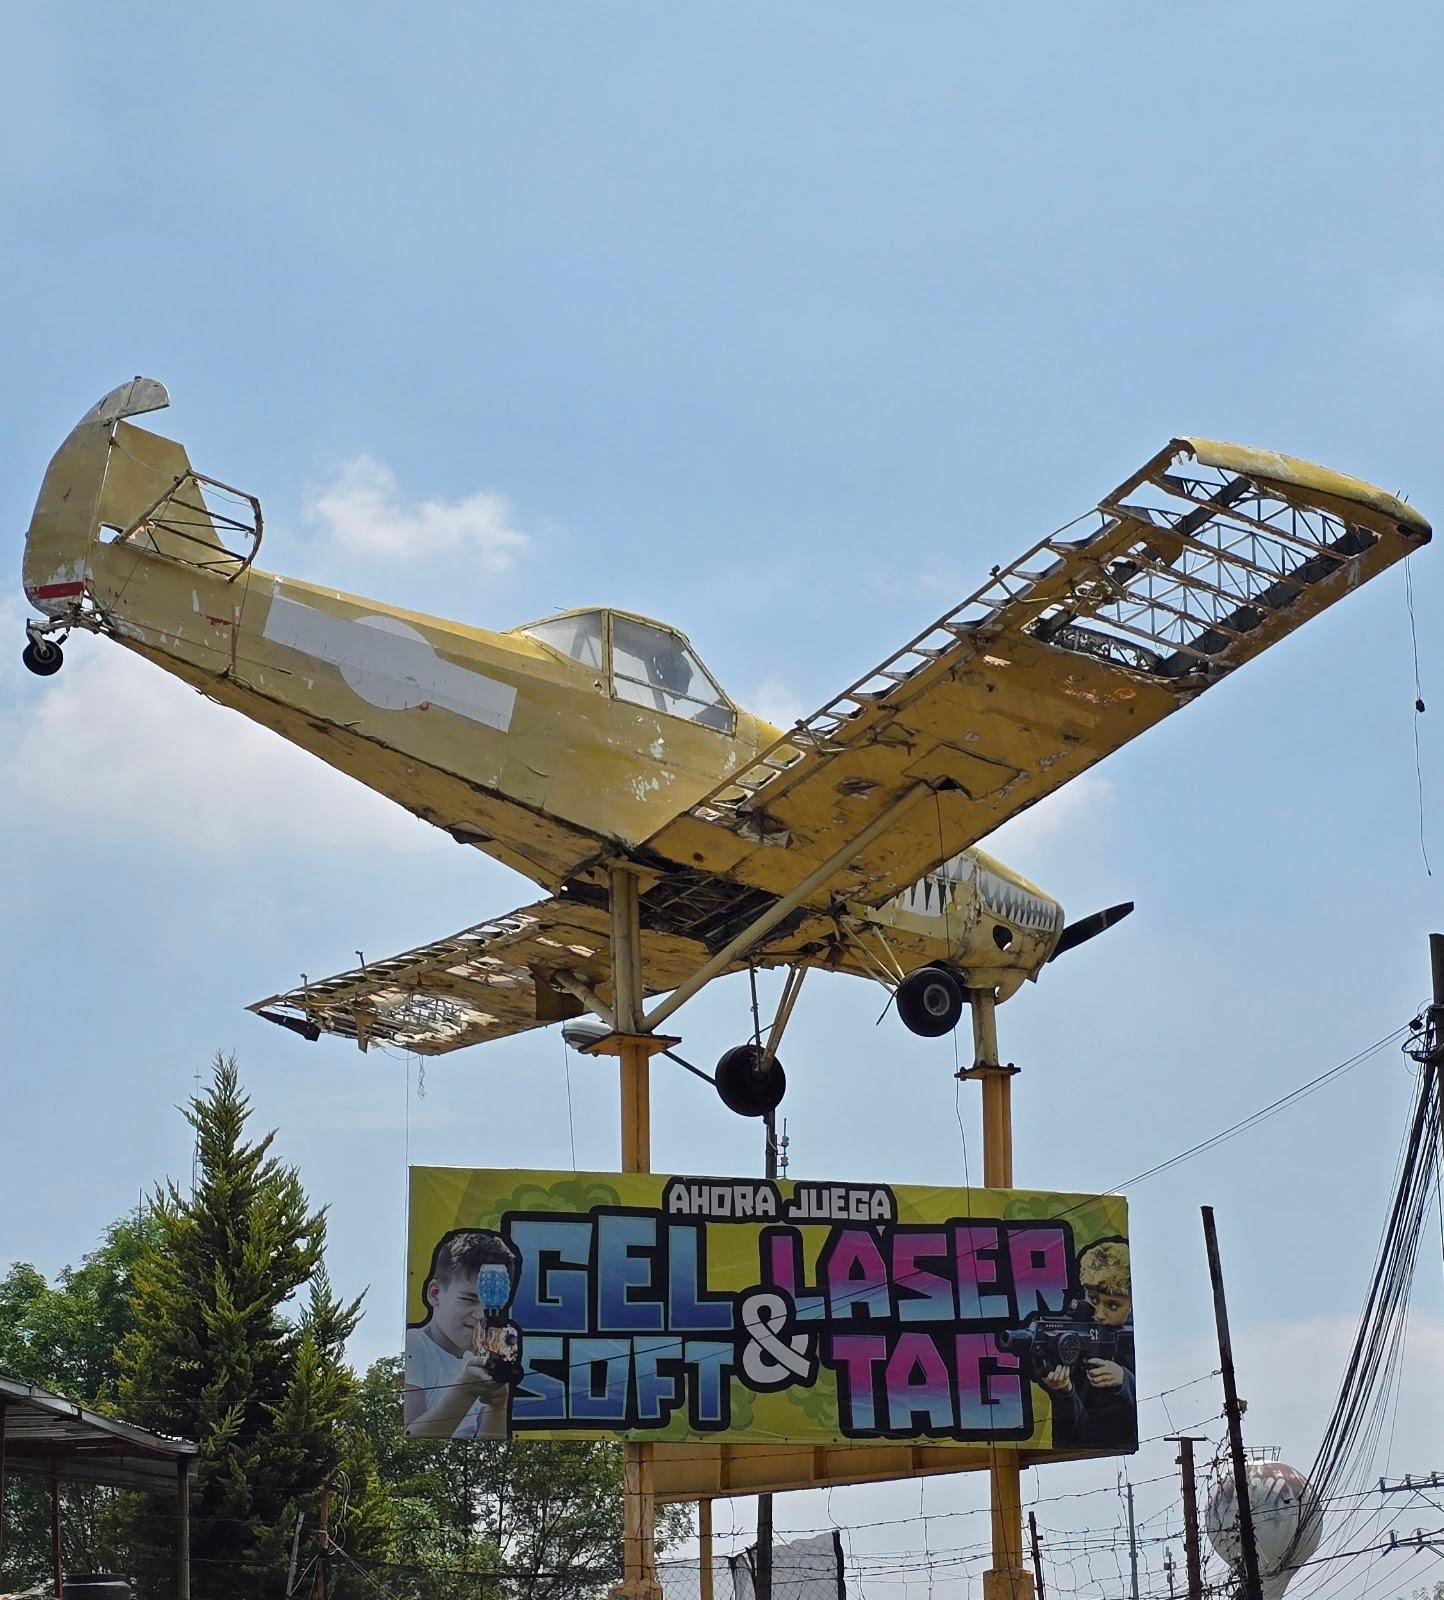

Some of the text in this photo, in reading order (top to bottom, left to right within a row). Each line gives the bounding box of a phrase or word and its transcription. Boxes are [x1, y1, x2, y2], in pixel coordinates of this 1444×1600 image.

[668, 1183, 892, 1220] AHORA JUEGA
[508, 1214, 735, 1334] GEL
[769, 1226, 1069, 1323] LASER
[510, 1336, 735, 1421] SOFT
[741, 1292, 812, 1384] &
[831, 1331, 1025, 1431] TAG
